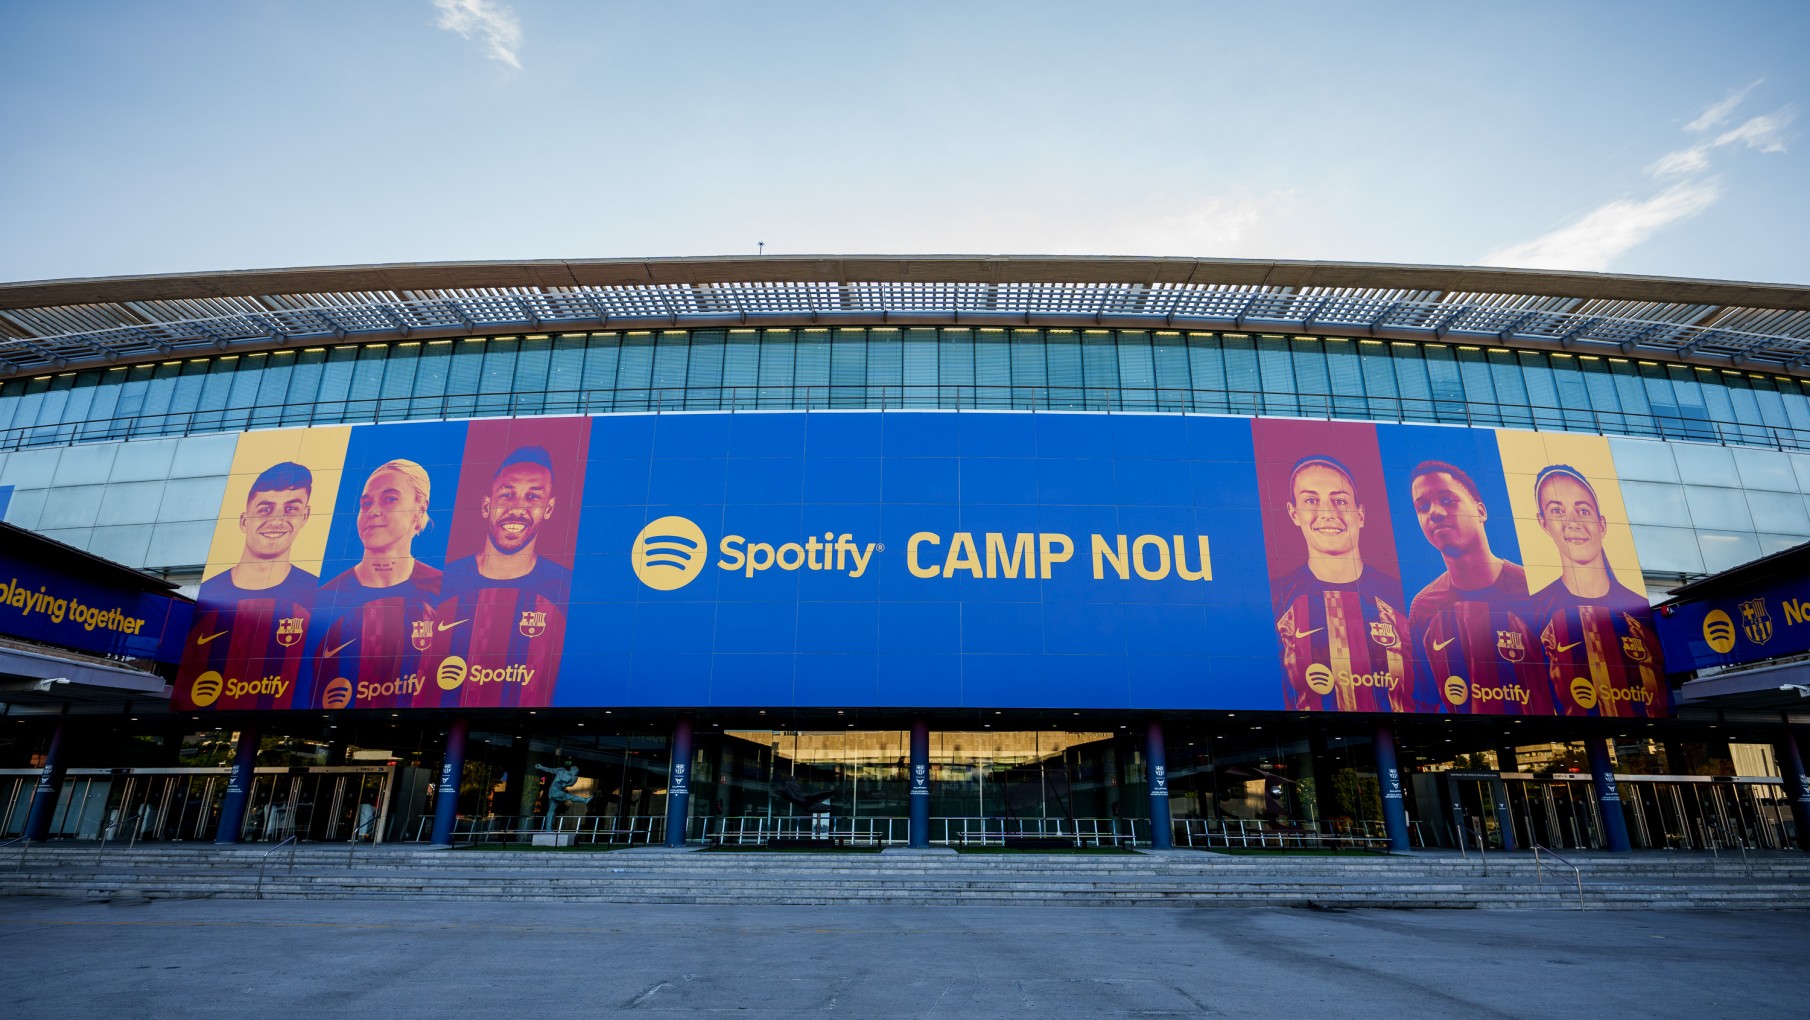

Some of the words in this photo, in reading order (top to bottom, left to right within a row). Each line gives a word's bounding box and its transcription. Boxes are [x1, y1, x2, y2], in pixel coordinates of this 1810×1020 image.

[907, 531, 1075, 579] CAMP
[1091, 533, 1213, 581] NOU
[69, 598, 145, 635] together
[469, 663, 535, 686] Spotify
[1338, 670, 1399, 691] Spotify
[225, 675, 289, 699] Spotify
[356, 673, 426, 700] Spotify
[1471, 683, 1531, 705] Spotify
[1600, 684, 1654, 706] Spotify
